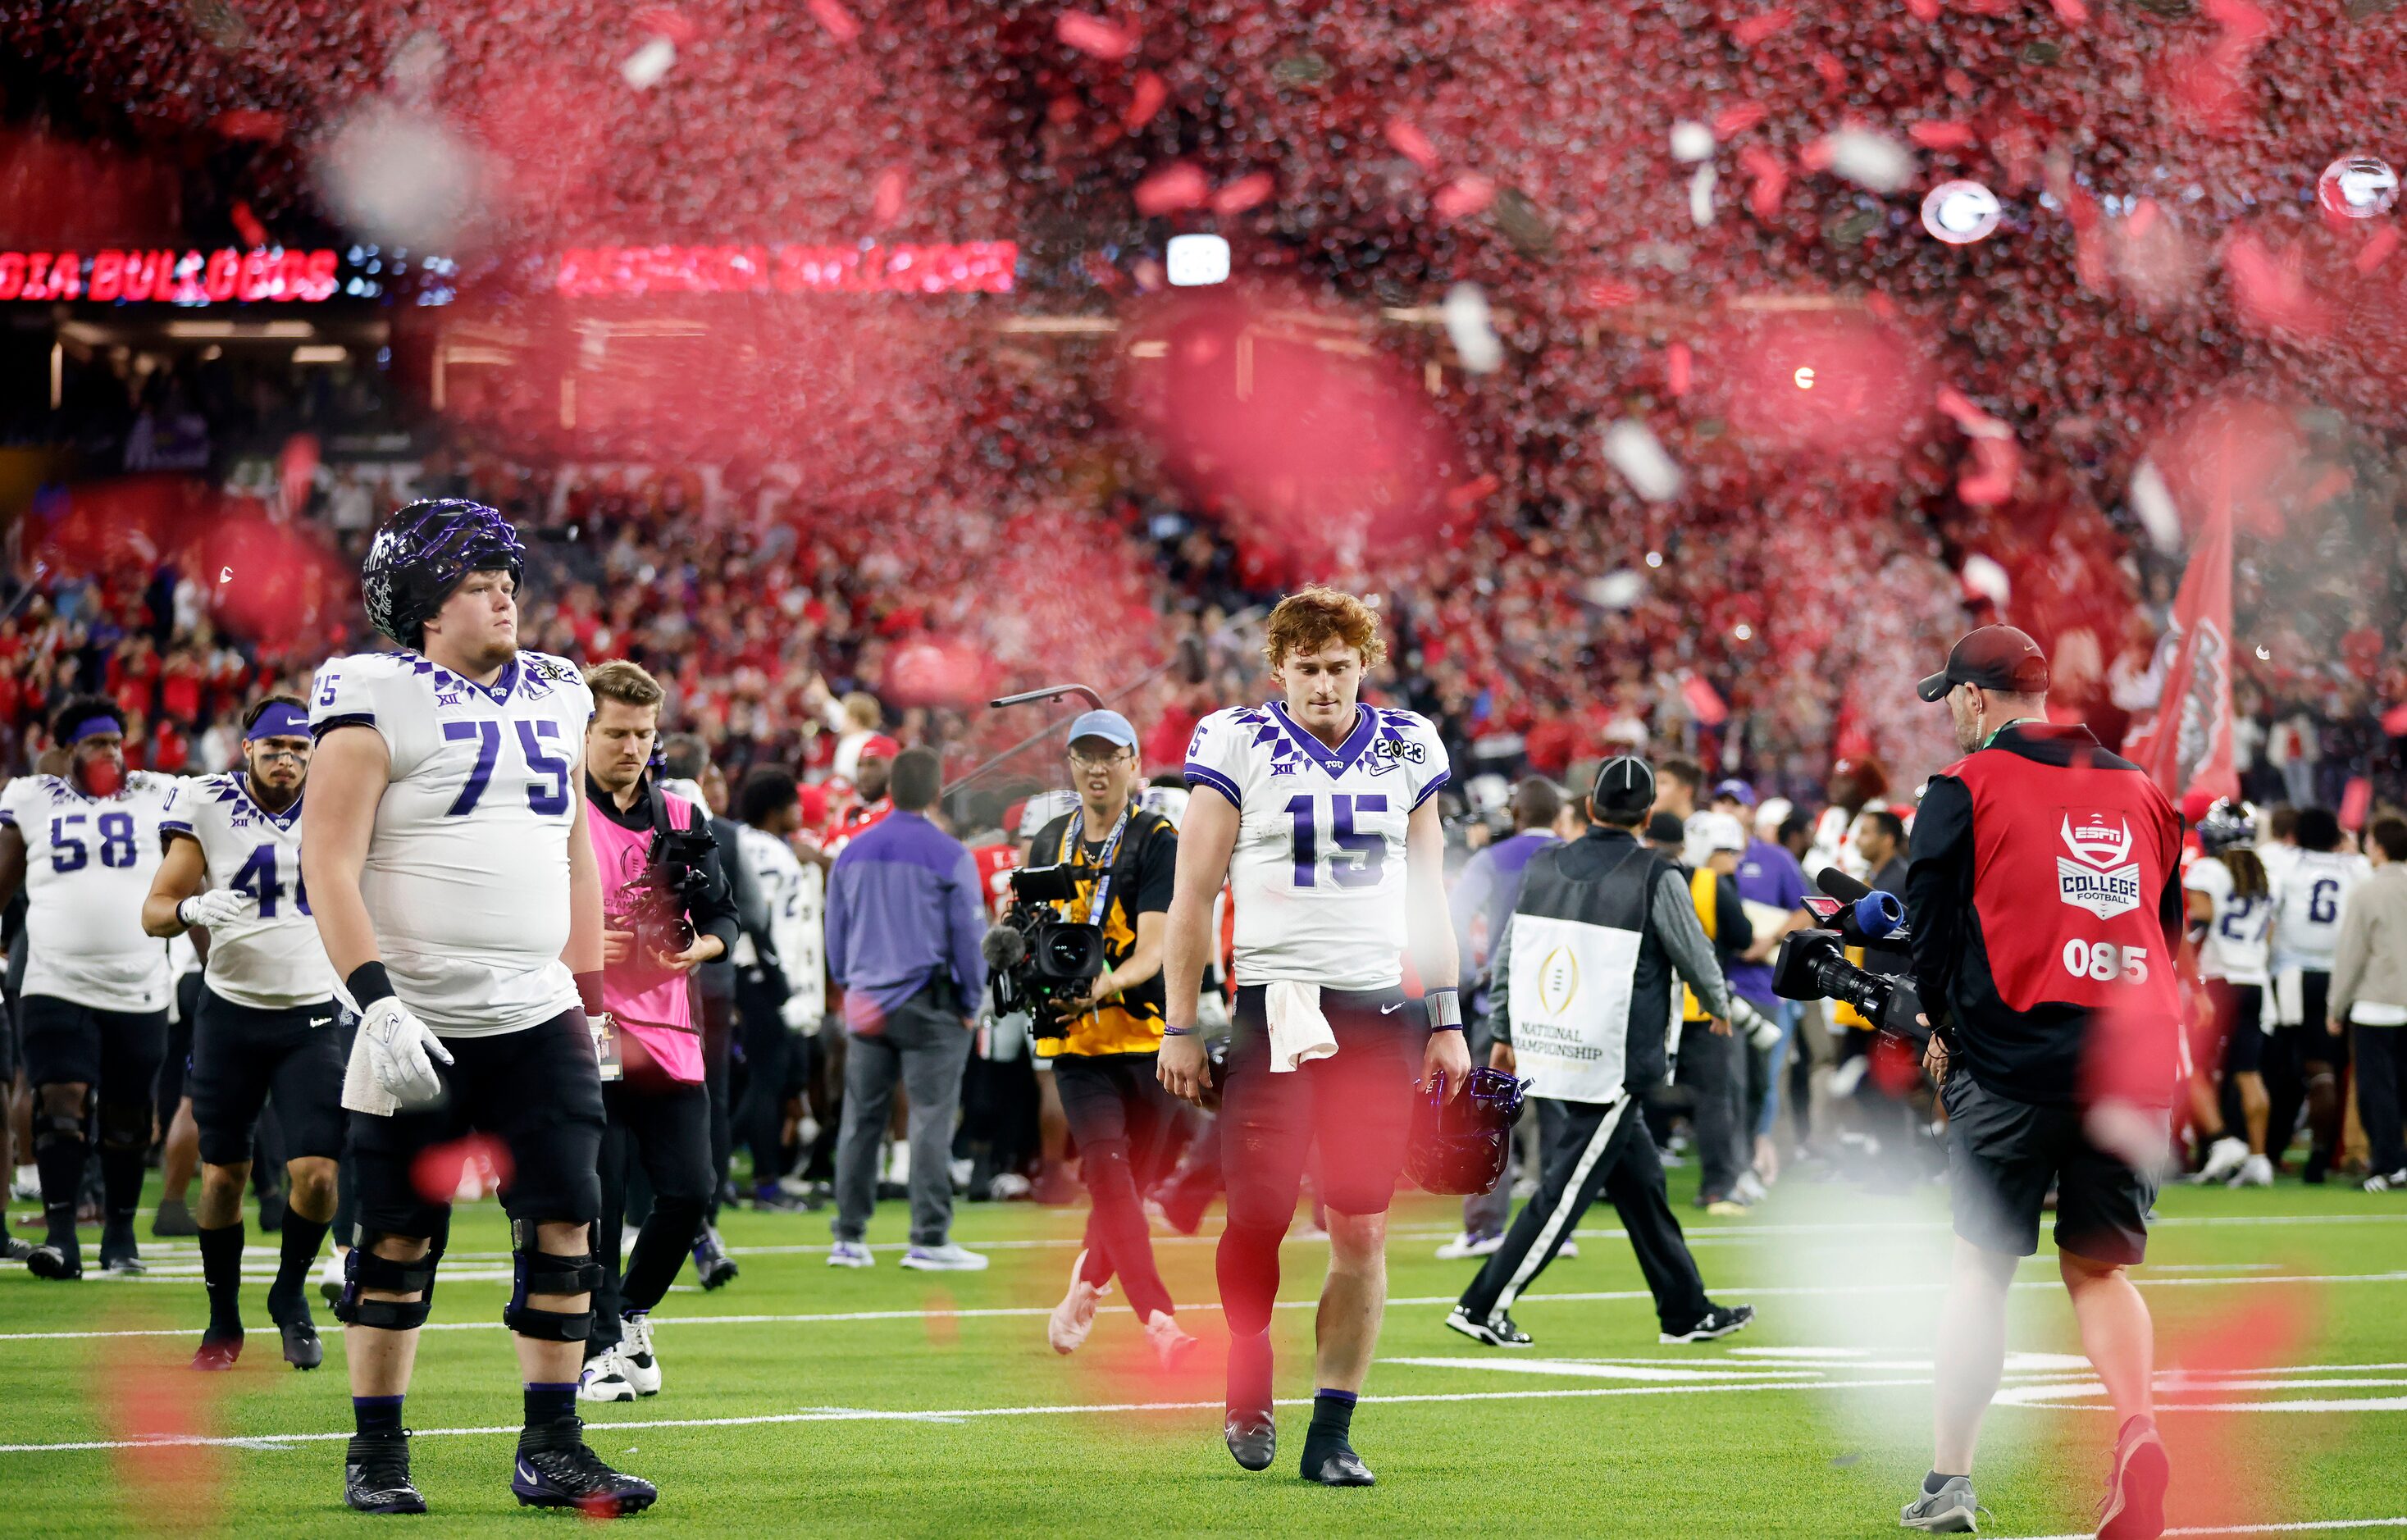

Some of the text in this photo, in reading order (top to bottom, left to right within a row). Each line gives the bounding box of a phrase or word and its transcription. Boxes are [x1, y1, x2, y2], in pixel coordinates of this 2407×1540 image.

[435, 692, 462, 708] XII
[490, 687, 508, 697] TCU
[1188, 723, 1209, 758] 5
[441, 718, 572, 817] 75
[1272, 762, 1297, 776] XII
[1324, 759, 1344, 770] TCU
[51, 812, 138, 873] 58
[1284, 794, 1388, 888] 15
[2075, 827, 2121, 843] ESPN
[2063, 873, 2137, 898] COLLEGE
[2077, 892, 2130, 904] FOOTBALL
[2062, 938, 2149, 985] 085
[1520, 1021, 1584, 1043] NATIONAL
